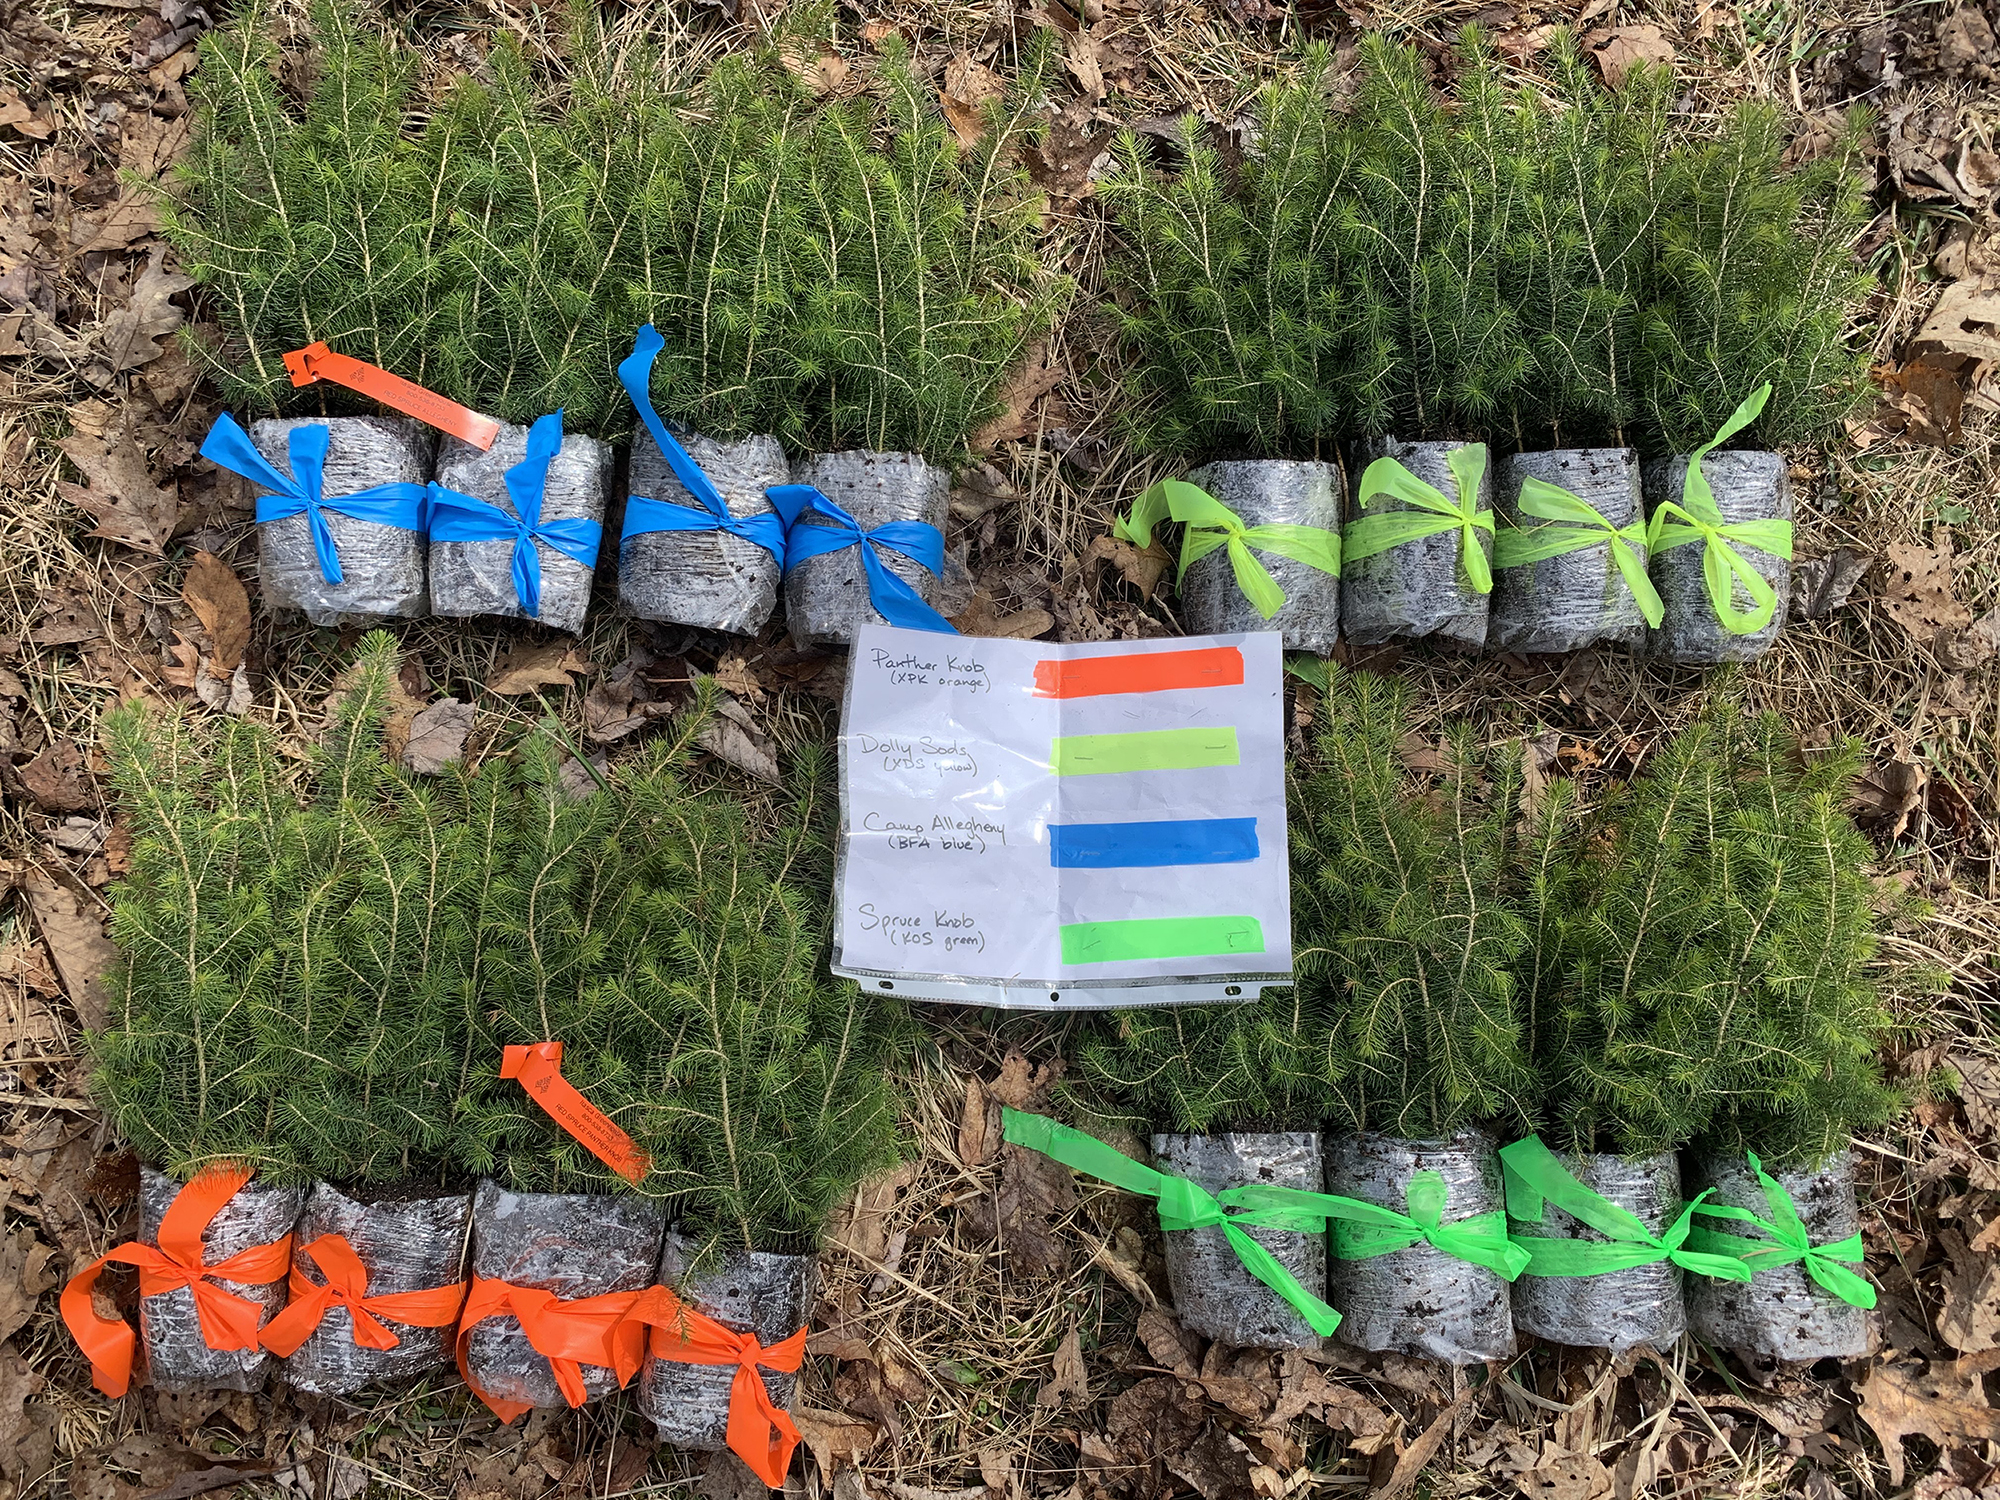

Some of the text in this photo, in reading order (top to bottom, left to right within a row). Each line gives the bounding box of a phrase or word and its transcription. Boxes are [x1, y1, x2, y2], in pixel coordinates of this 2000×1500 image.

[383, 390, 457, 427] RED SPRUCE ALLEGHENY
[871, 648, 985, 673] Panther Knob
[891, 670, 991, 693] (XPK orange)
[856, 733, 967, 761] Dolly Sods
[884, 756, 925, 771] (XDS
[863, 812, 1007, 846] Camp Allegheny
[888, 834, 986, 854] (BFA blue)
[859, 903, 974, 936] Spruce Knob
[891, 930, 985, 953] (KOS green)
[555, 1103, 623, 1163] RED SPRUCE PANTHER KNOB
